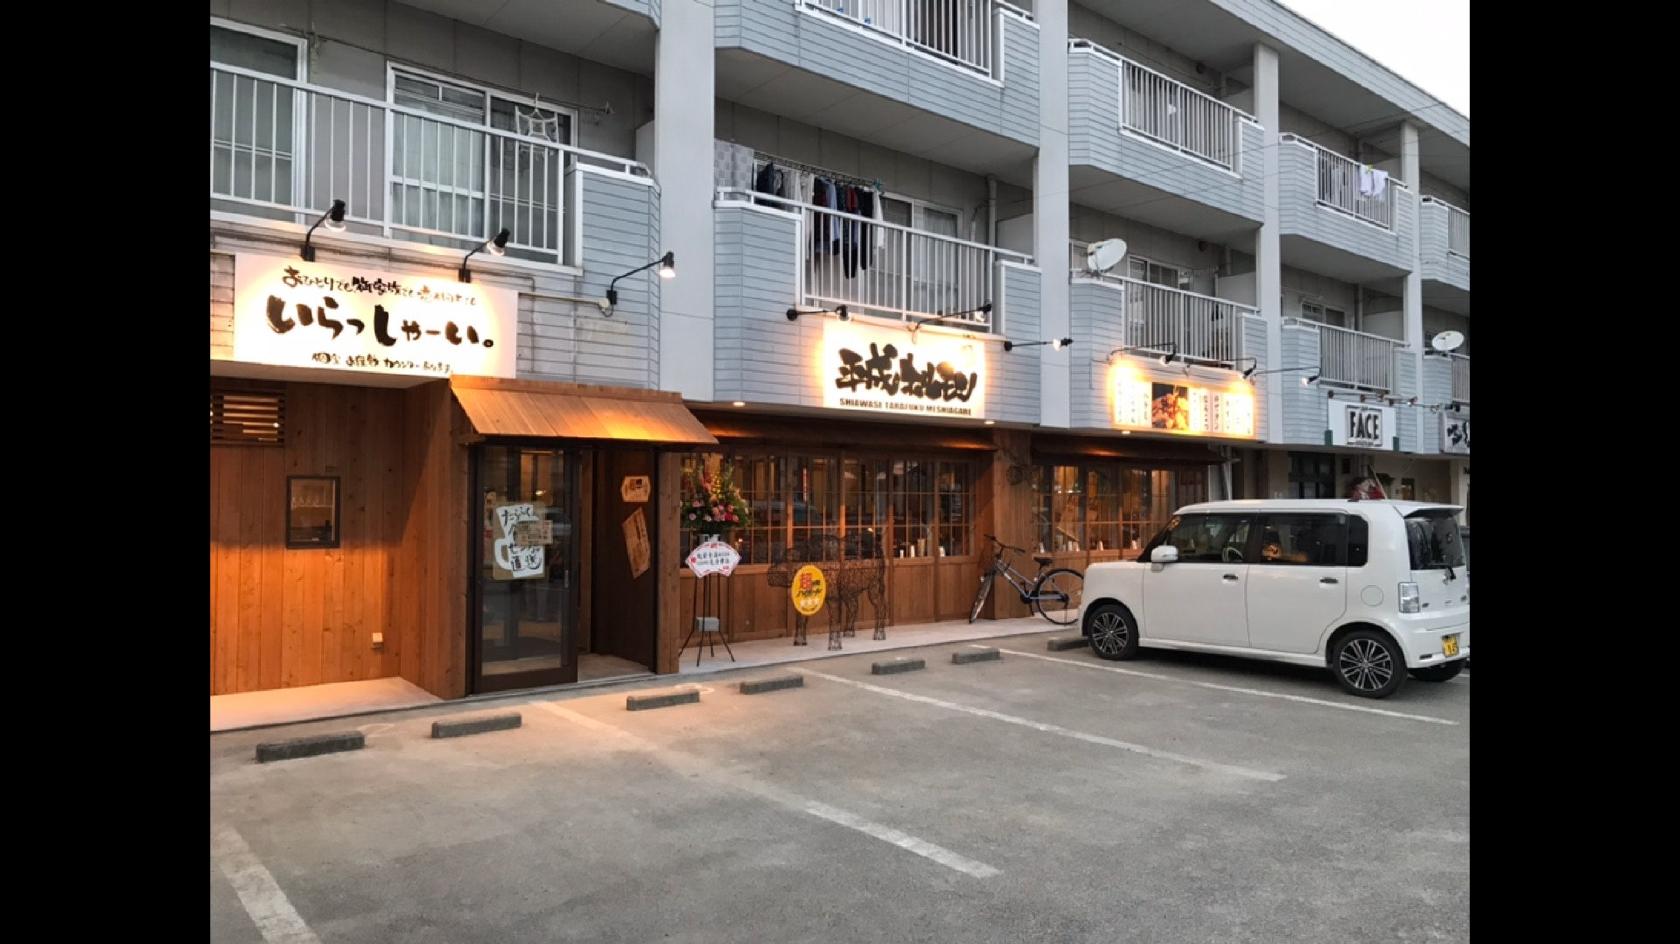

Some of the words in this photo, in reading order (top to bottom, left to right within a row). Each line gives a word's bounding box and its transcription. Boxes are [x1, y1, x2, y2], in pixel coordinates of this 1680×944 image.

[266, 295, 494, 347] いらっしゃーい。
[1349, 411, 1380, 440] FACE
